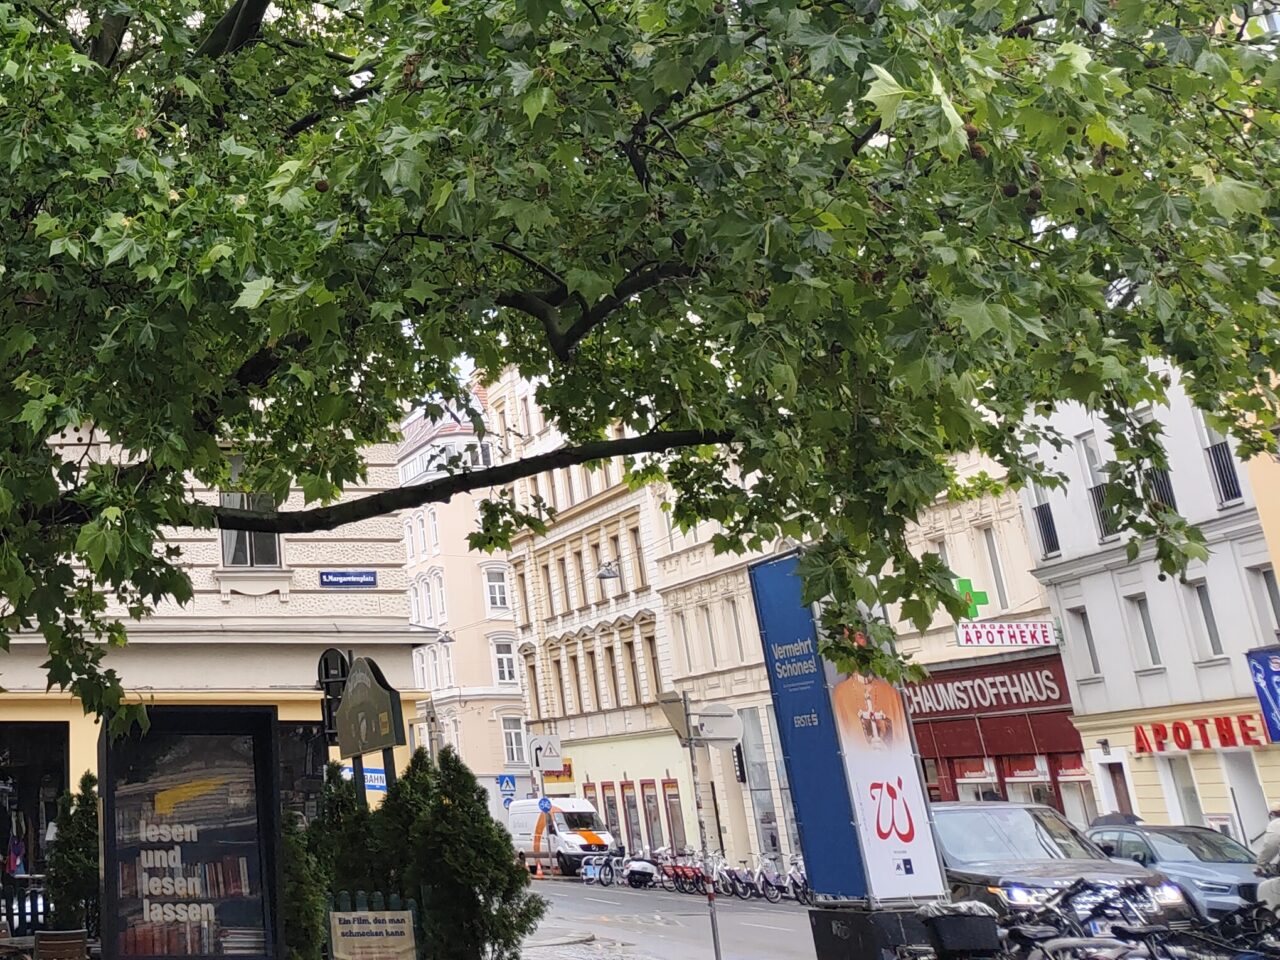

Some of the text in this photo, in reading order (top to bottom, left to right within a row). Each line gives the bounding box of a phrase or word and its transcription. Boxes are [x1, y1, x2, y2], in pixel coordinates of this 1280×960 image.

[771, 637, 813, 660] Vermehrt
[965, 630, 1051, 645] APOTHEKE
[775, 655, 817, 678] Schönes!
[904, 669, 1061, 714] CHAUMSTOFFHAUS
[1134, 713, 1270, 753] APOTHE
[140, 820, 198, 842] lesen
[140, 845, 181, 868] und
[142, 872, 201, 897] lesen
[143, 899, 215, 923] lassen
[339, 917, 351, 925] Ein
[373, 916, 386, 924] den
